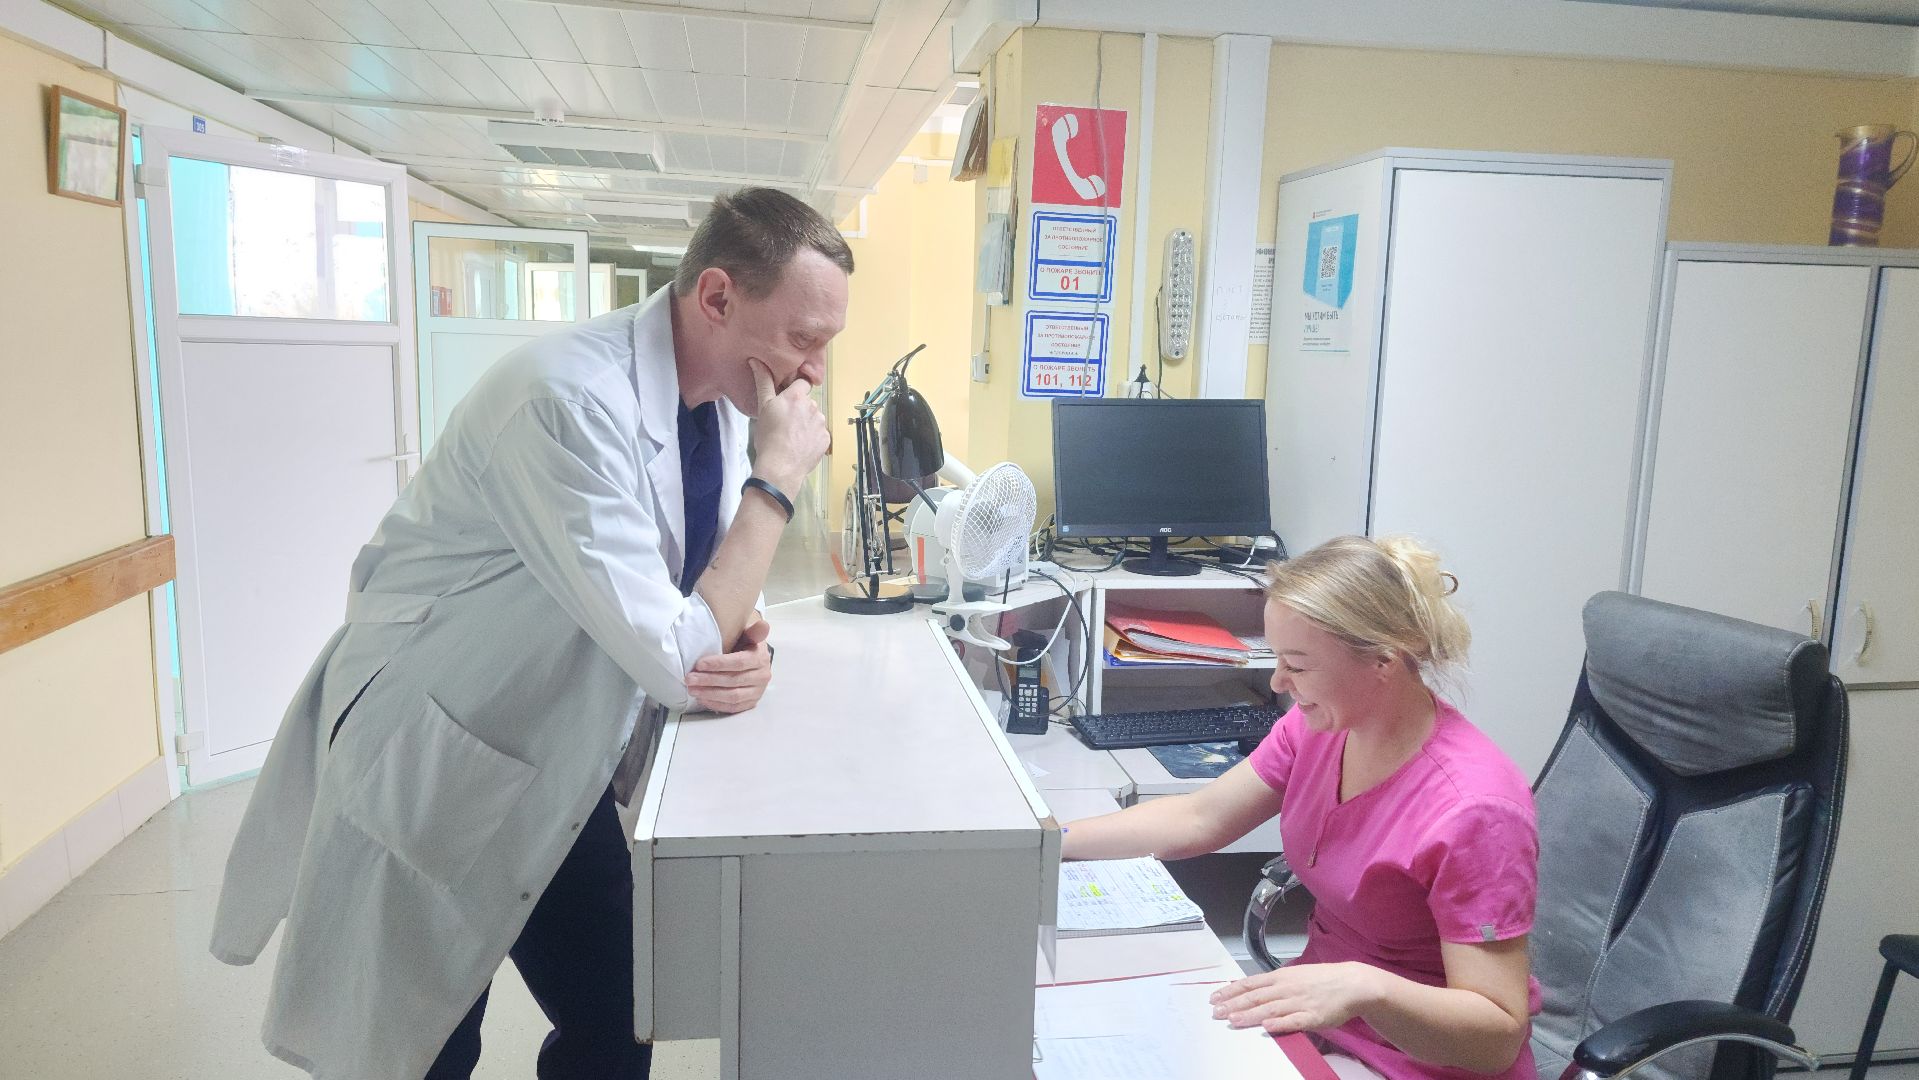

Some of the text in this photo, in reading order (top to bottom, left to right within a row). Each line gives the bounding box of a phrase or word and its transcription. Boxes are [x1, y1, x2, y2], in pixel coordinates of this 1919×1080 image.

[1046, 267, 1073, 275] ПОЖАРЕ
[1060, 275, 1080, 291] 01
[1036, 373, 1092, 388] 101, 112
